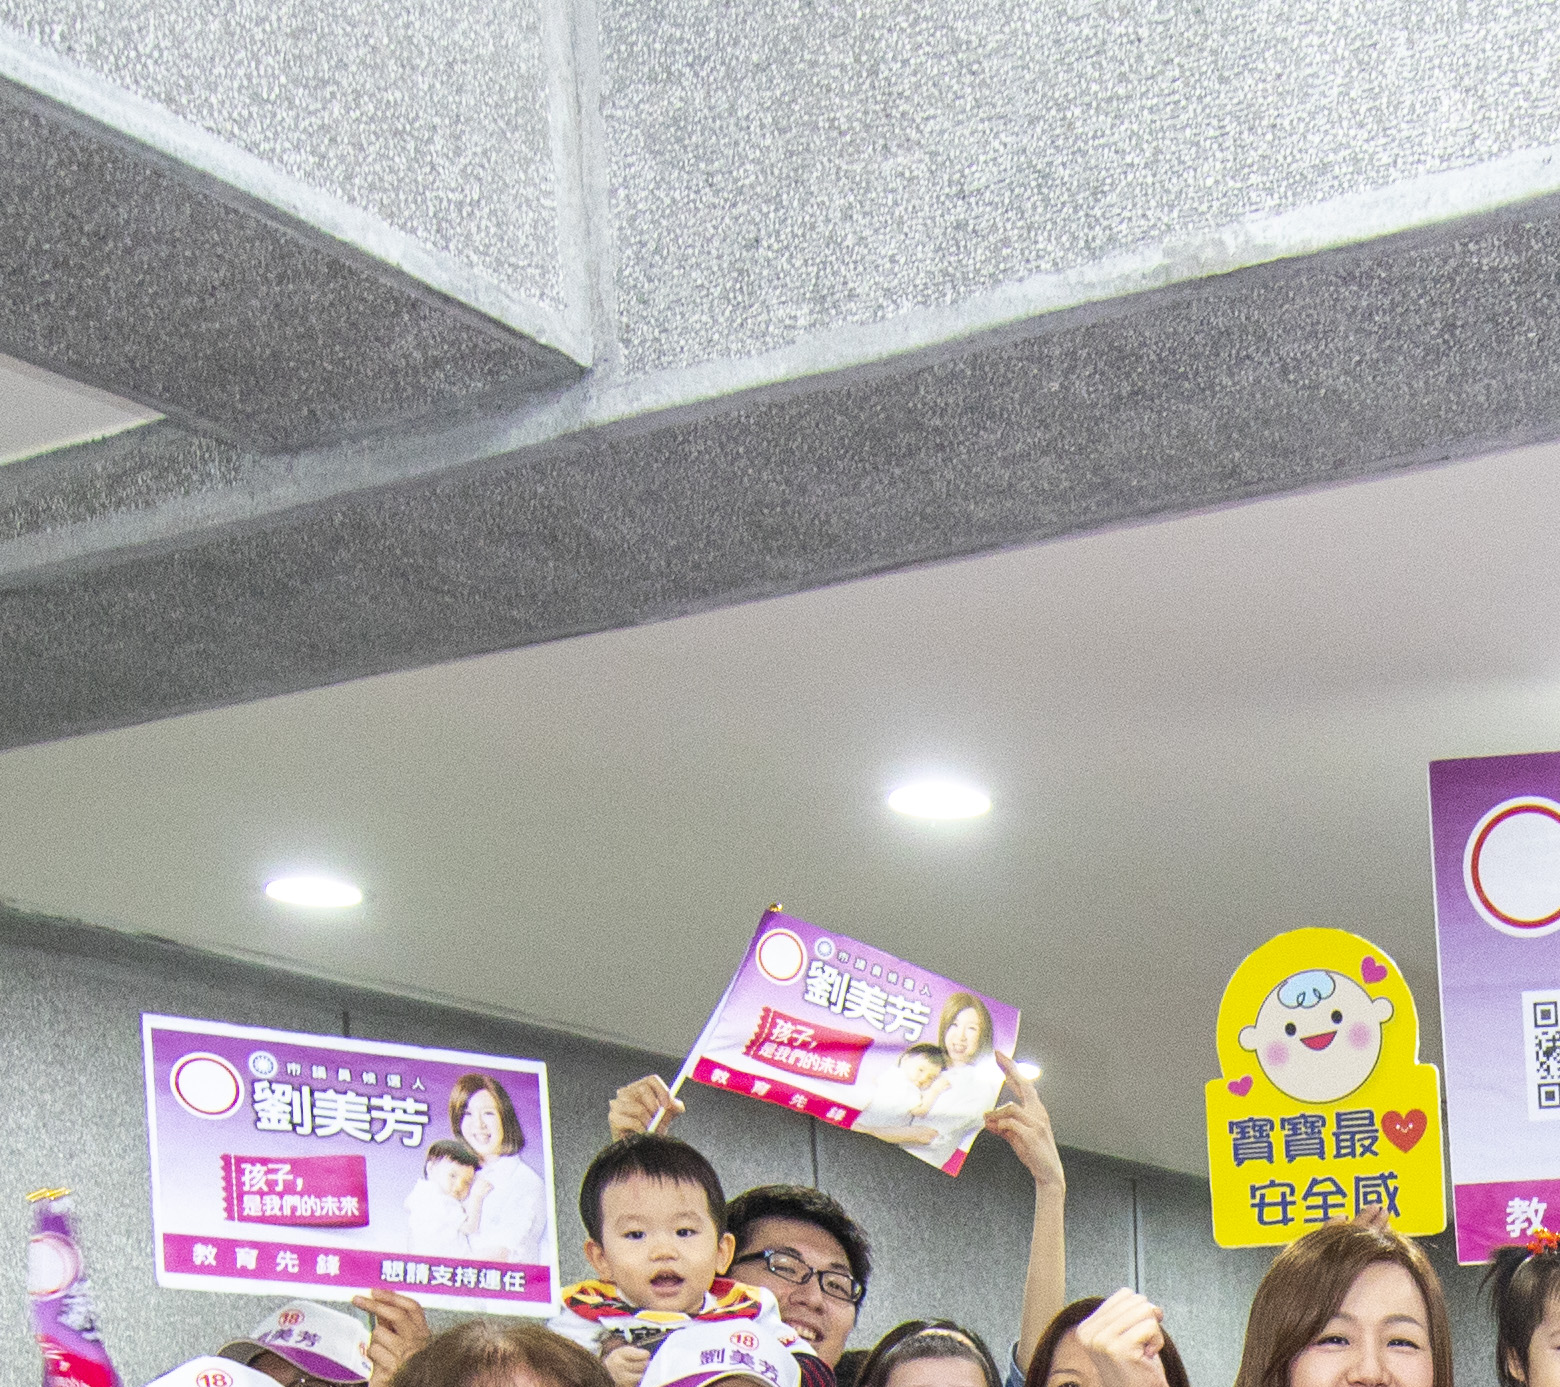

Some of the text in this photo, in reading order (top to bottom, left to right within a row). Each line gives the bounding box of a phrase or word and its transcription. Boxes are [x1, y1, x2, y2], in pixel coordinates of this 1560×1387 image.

[803, 957, 931, 1043] 劉美芳
[769, 1012, 819, 1049] 孩子，
[758, 1041, 852, 1081] 是我們的未來
[251, 1078, 429, 1148] 劉美芳
[711, 1067, 849, 1125] 教育先鋒
[1228, 1111, 1382, 1166] 寶寶最
[241, 1162, 305, 1192] 孩子，
[241, 1194, 359, 1219] 是我們的未來
[1250, 1171, 1402, 1226] 安全感
[192, 1243, 341, 1277] 教育先鋒
[381, 1260, 526, 1293] 懇請支持連任
[735, 1334, 754, 1348] 18
[201, 1373, 228, 1387] 18
